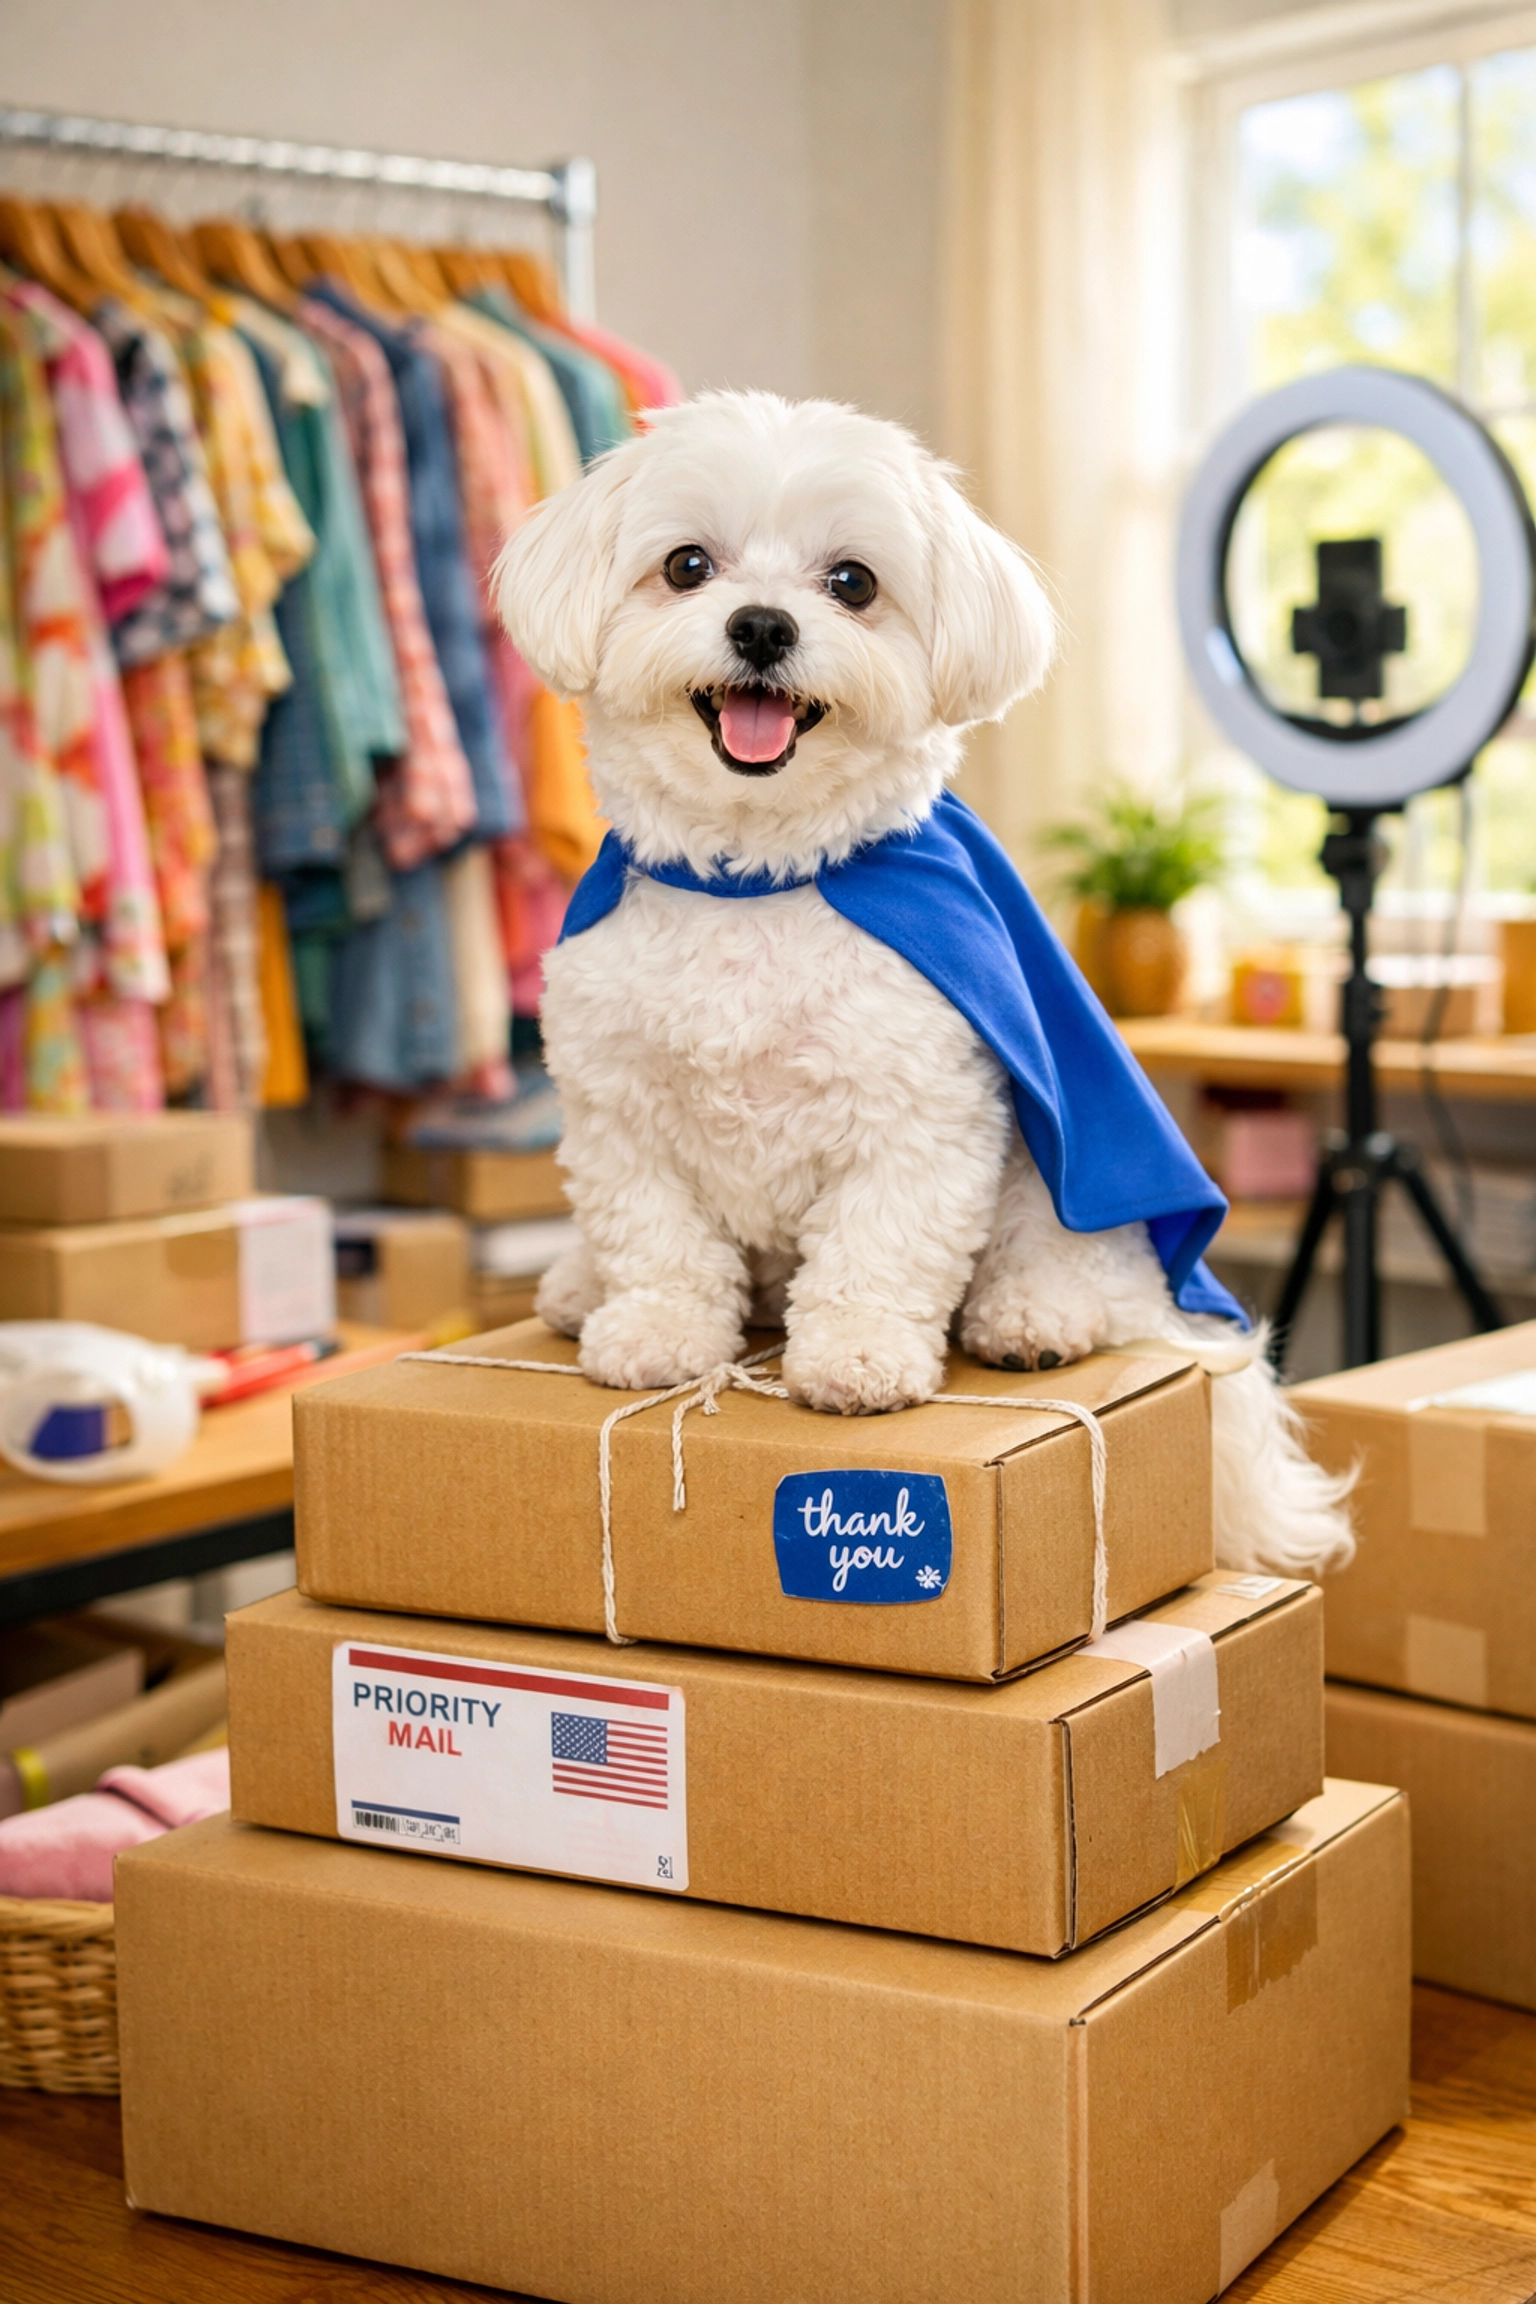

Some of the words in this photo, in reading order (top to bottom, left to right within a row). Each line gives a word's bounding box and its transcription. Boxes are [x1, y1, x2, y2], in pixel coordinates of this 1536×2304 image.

[797, 1487, 925, 1537] thank
[829, 1544, 905, 1592] you
[353, 1682, 502, 1728] PRIORITY
[388, 1720, 463, 1757] MAIL
